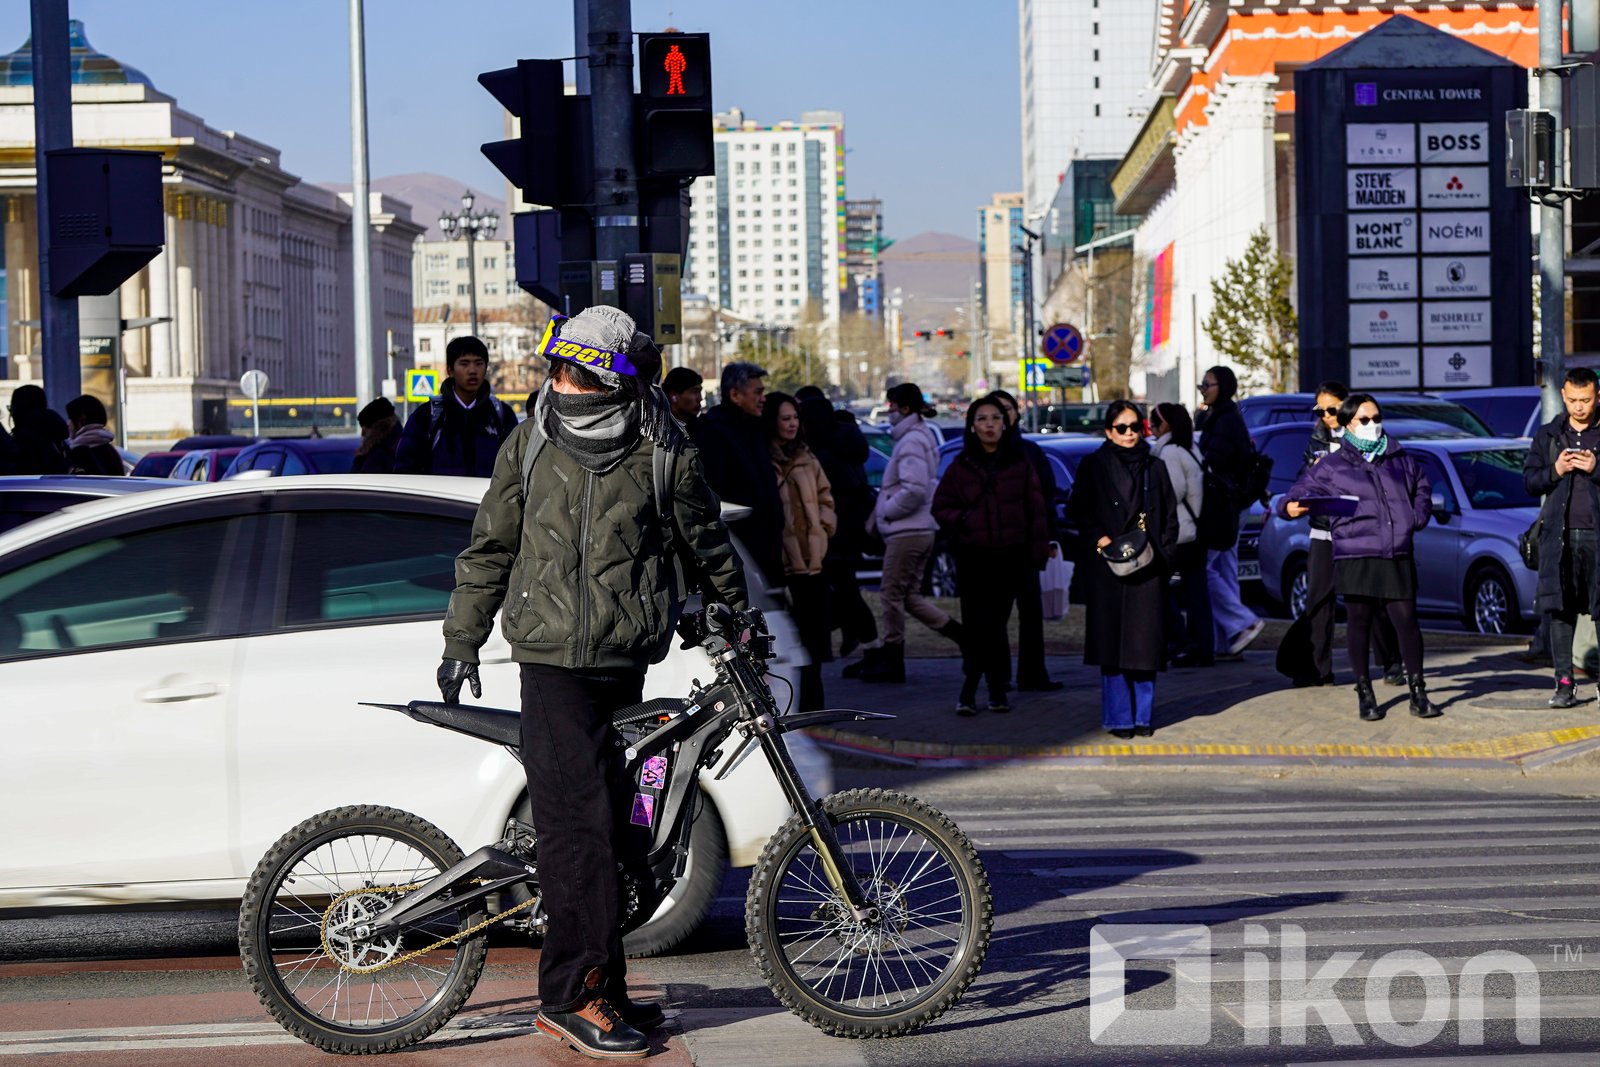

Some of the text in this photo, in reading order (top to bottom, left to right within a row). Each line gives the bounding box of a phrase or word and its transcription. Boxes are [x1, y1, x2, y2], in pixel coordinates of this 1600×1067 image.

[1383, 88, 1482, 100] CENTRAL TOWER
[1427, 134, 1480, 150] BOSS
[1355, 173, 1392, 188] STEVE
[1355, 190, 1406, 205] MADDEN
[1356, 223, 1402, 235] MONT
[1356, 237, 1403, 249] BLANC
[1431, 312, 1483, 323] BISHRELT
[549, 339, 613, 369] 100%
